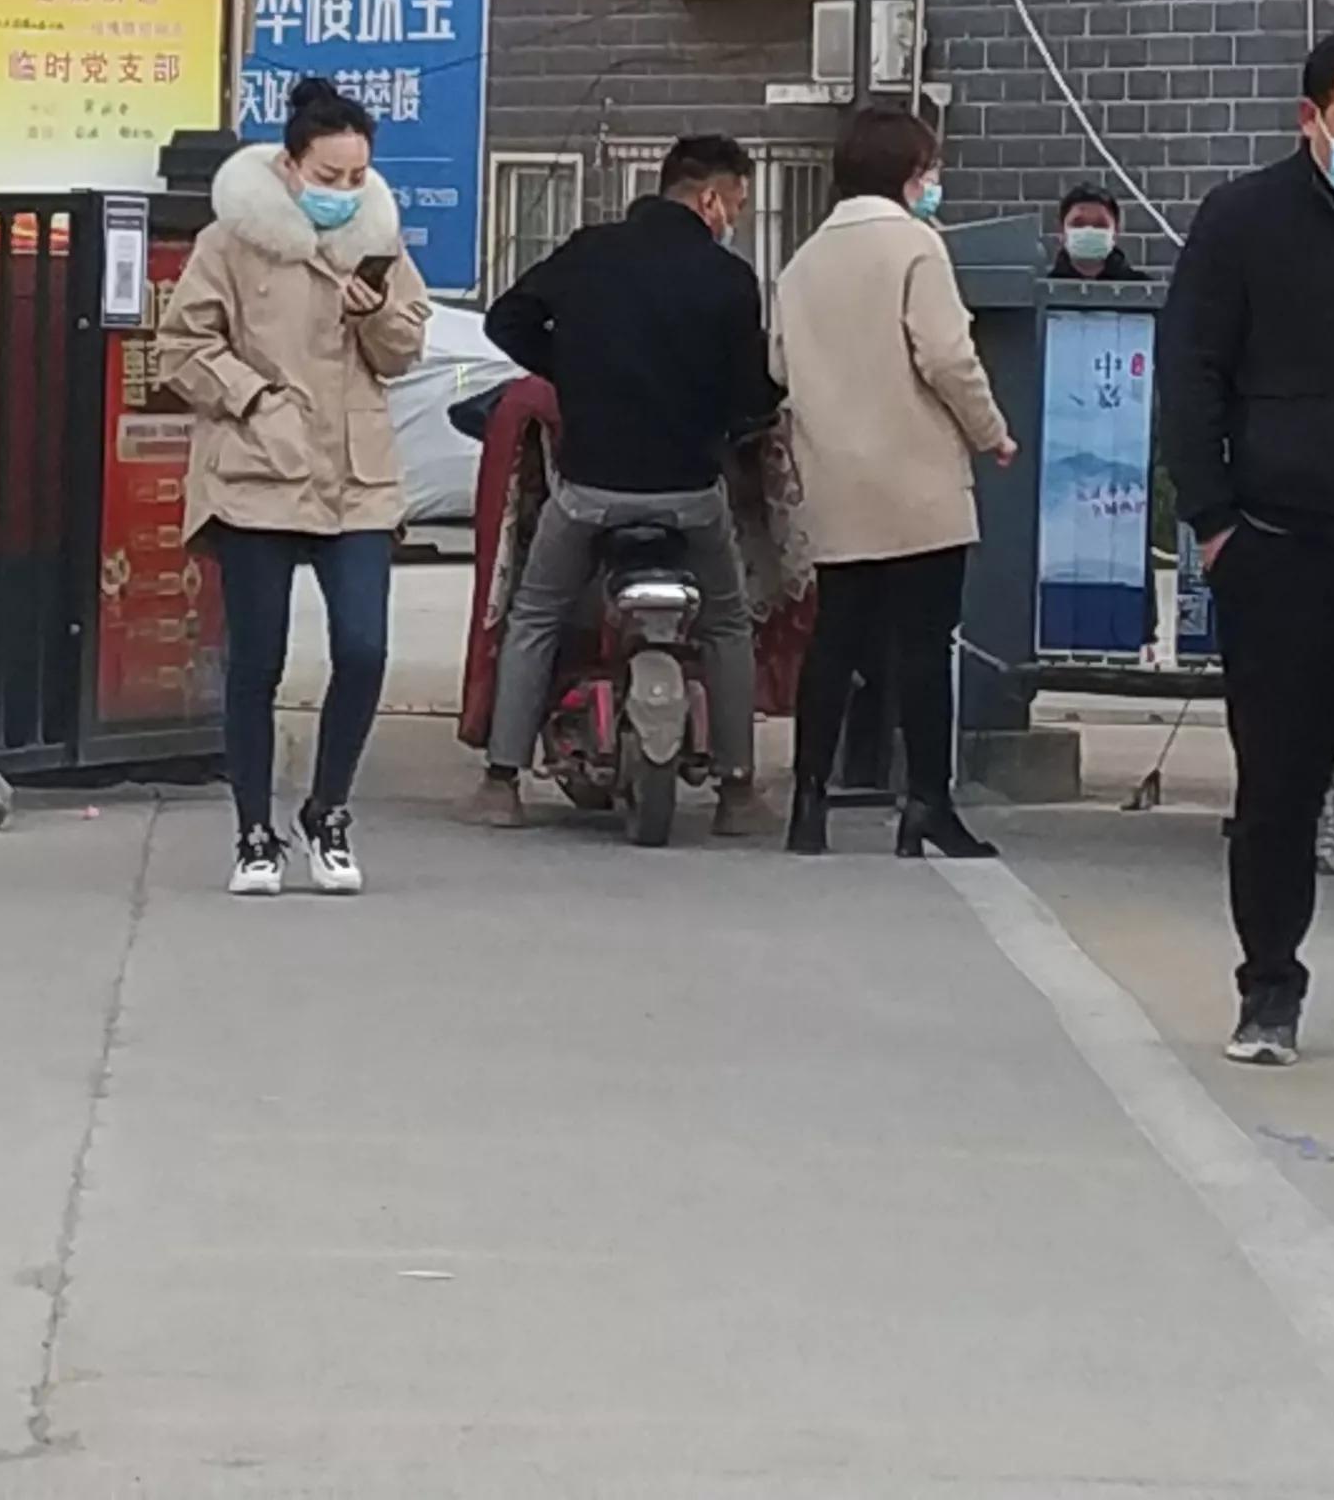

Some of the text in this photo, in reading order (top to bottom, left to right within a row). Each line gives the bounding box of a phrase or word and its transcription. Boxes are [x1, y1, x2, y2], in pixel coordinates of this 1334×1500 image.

[8, 51, 180, 83] 临时党支部
